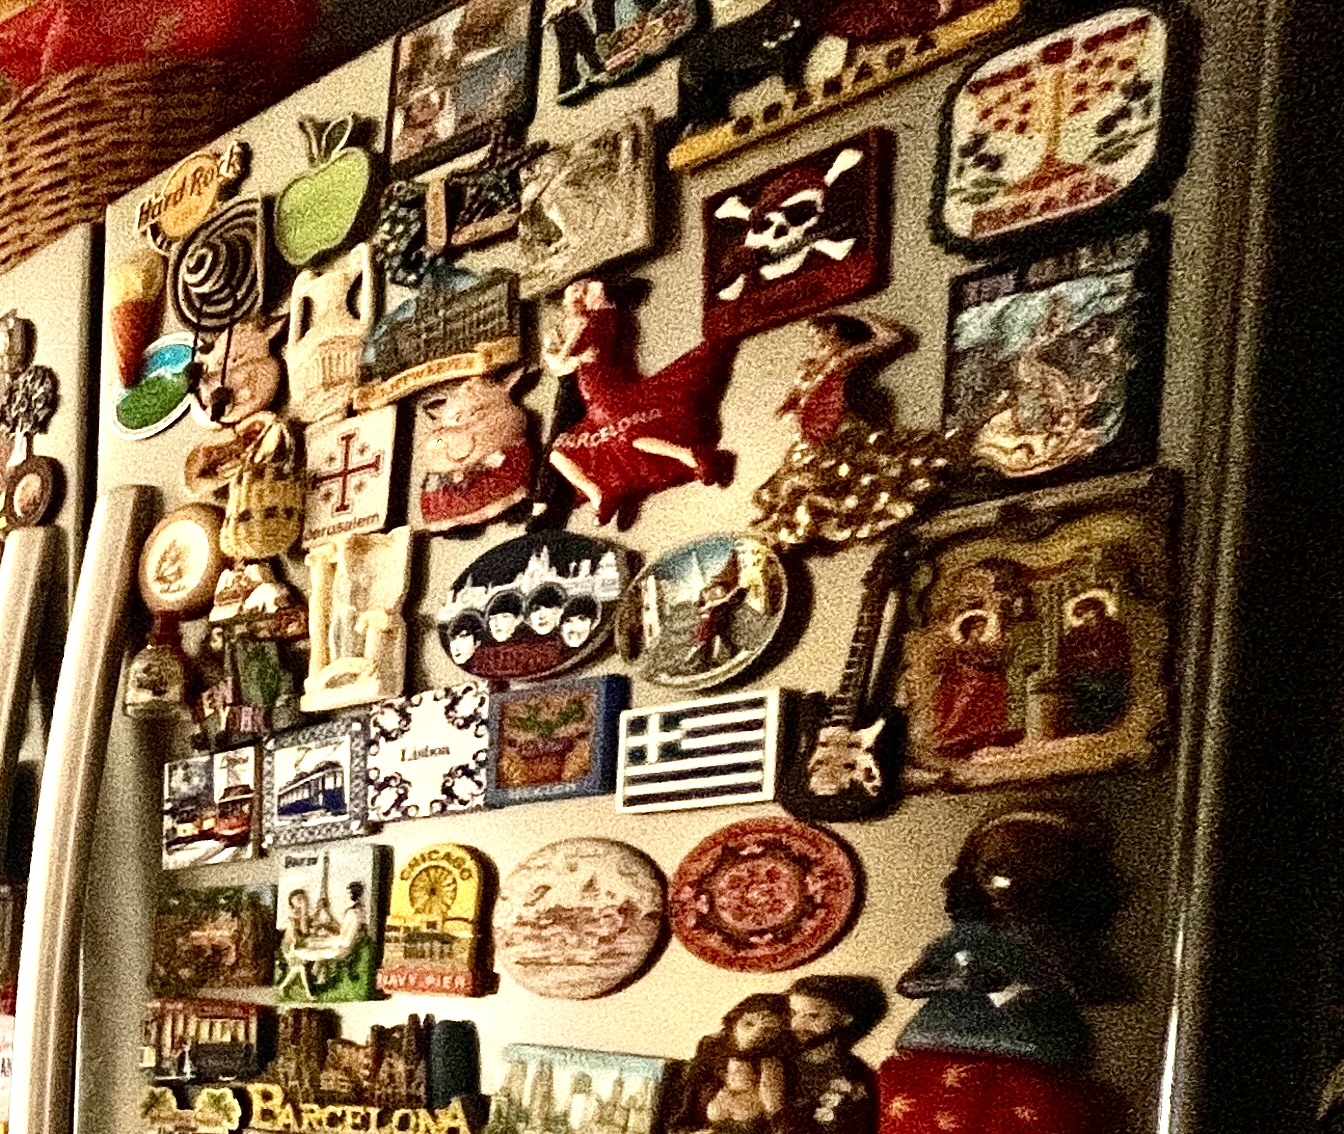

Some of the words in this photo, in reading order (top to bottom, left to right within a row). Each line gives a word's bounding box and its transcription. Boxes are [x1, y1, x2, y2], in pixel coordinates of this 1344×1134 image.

[137, 175, 188, 229] Hard
[189, 144, 241, 197] Rock
[552, 407, 662, 449] BARCELONA
[307, 513, 380, 540] Jerusalem
[399, 849, 473, 881] CHICAGO
[379, 970, 418, 989] NAVY
[423, 973, 467, 991] PIER
